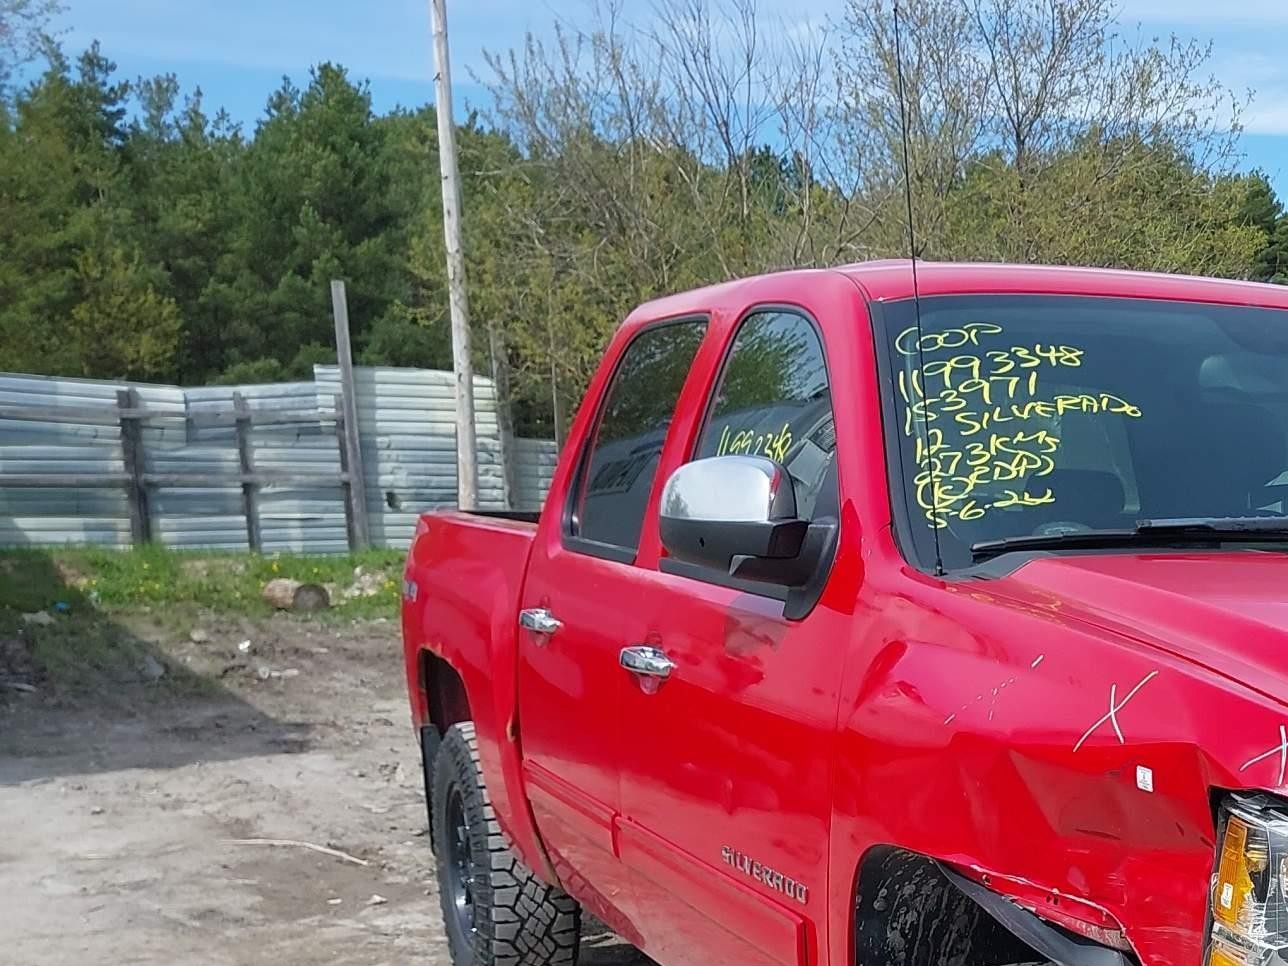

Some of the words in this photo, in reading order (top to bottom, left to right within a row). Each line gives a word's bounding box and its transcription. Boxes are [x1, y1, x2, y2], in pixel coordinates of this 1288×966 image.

[899, 344, 1083, 403] 11993348
[954, 393, 1142, 435] SILVERADO
[721, 845, 808, 904] SILVERADO
